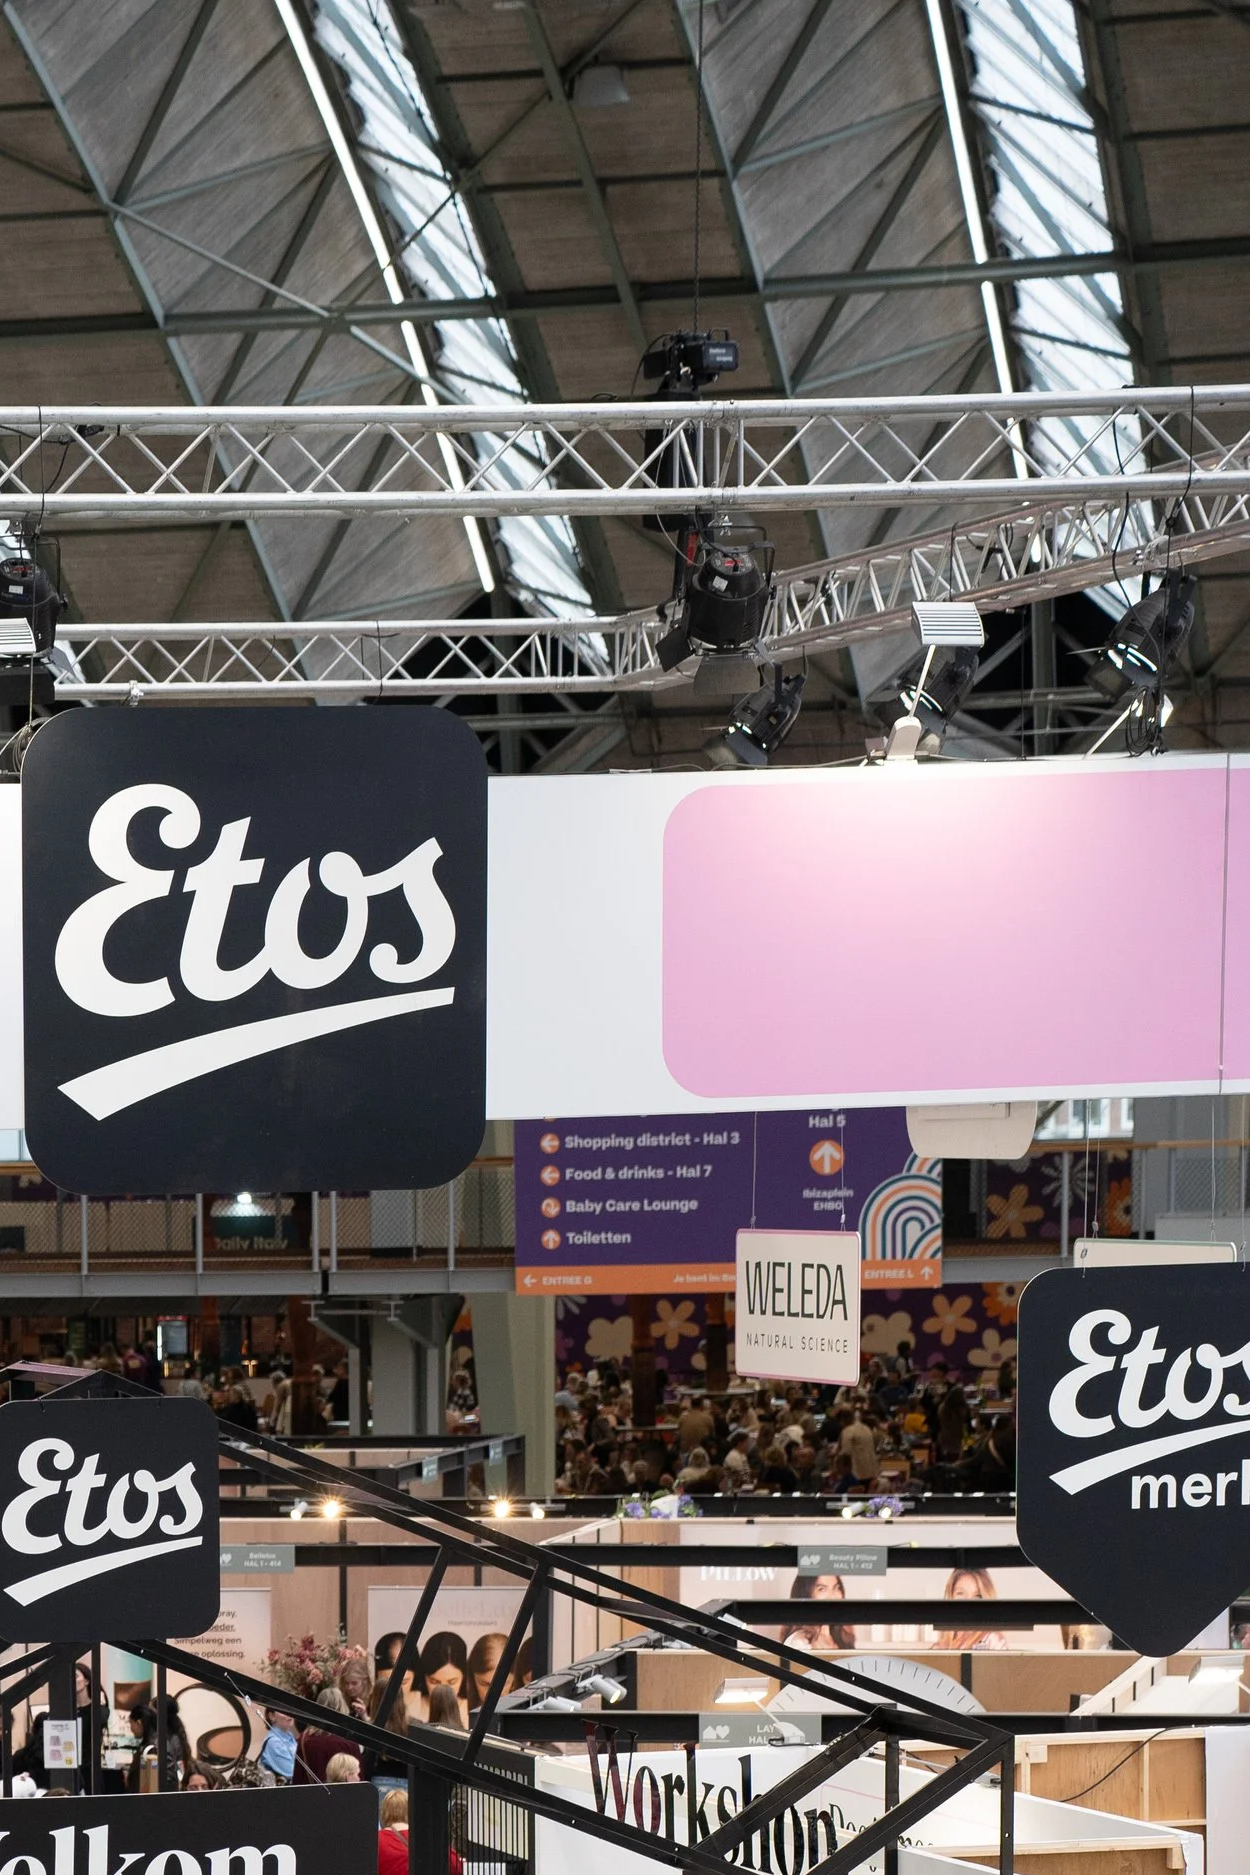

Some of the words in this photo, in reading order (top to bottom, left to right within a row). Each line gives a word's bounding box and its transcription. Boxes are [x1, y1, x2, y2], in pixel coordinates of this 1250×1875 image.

[55, 784, 456, 1017] Etos
[809, 1114, 833, 1128] Hal
[565, 1133, 634, 1151] Shopping
[637, 1131, 691, 1148] district
[702, 1131, 726, 1146] Hal
[729, 1131, 740, 1145] 3
[565, 1167, 601, 1182] Food
[604, 1167, 615, 1181] &
[618, 1165, 664, 1181] drinks
[676, 1164, 699, 1179] Hal
[702, 1164, 712, 1178] 7
[566, 1199, 602, 1216] Baby
[604, 1198, 641, 1213] Care
[644, 1198, 698, 1215] Lounge
[566, 1230, 631, 1246] Toiletten
[746, 1260, 848, 1321] WELEDA
[746, 1332, 793, 1349] NATURAL
[801, 1336, 848, 1353] SCIENCE
[2, 1437, 204, 1555] Etos
